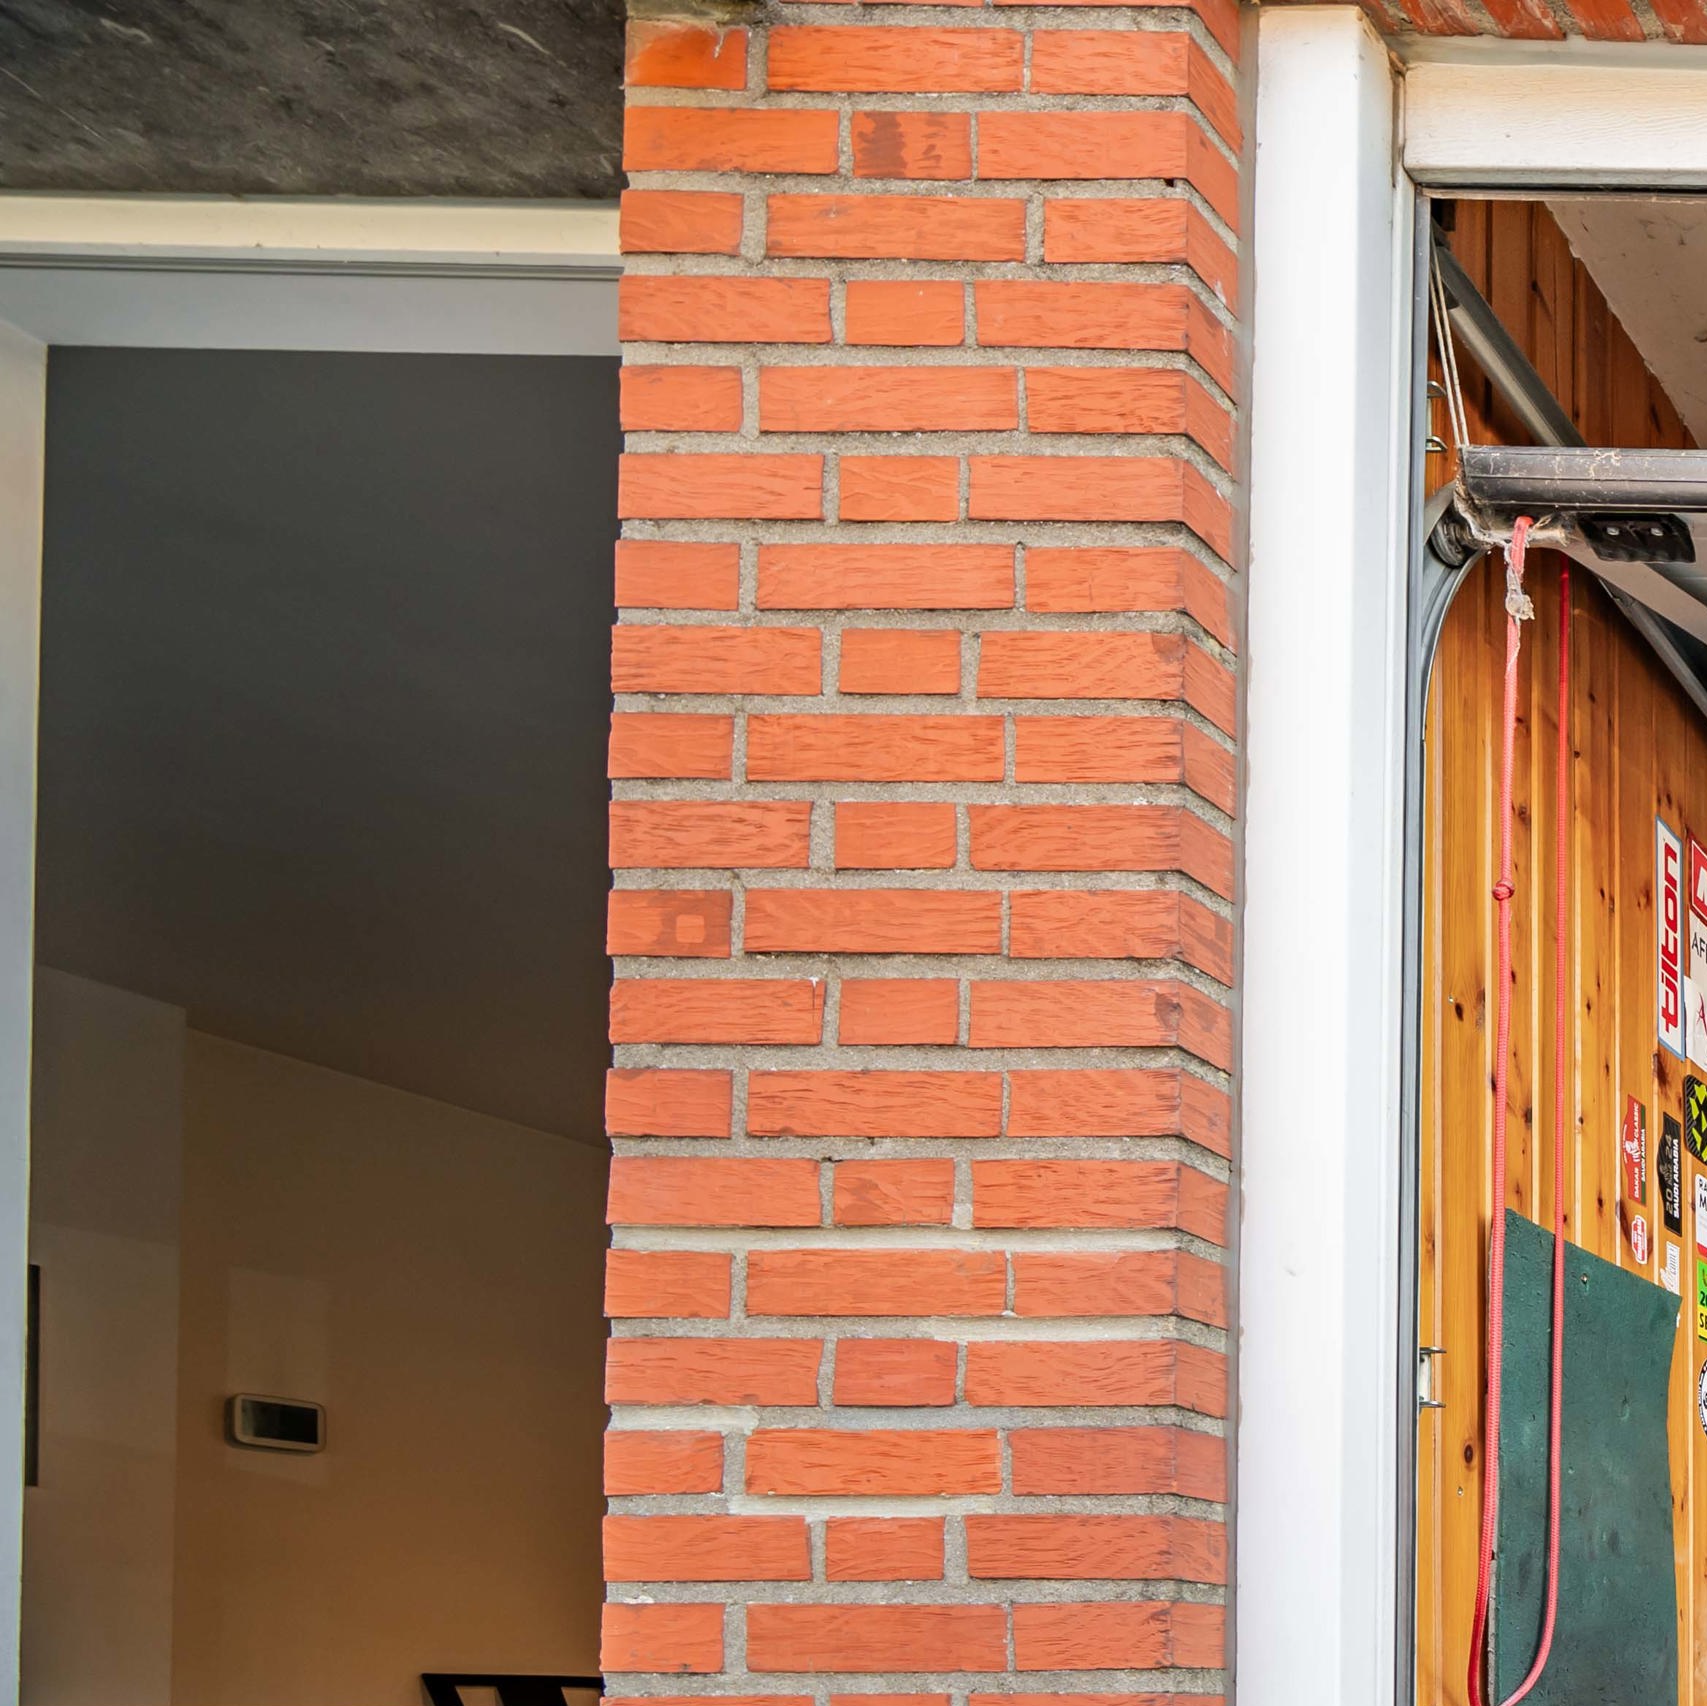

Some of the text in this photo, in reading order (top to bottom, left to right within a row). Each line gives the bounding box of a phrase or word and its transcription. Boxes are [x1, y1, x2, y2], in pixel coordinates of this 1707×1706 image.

[1661, 842, 1678, 1033] tilton
[1671, 1138, 1680, 1219] SAUDI ARABIA
